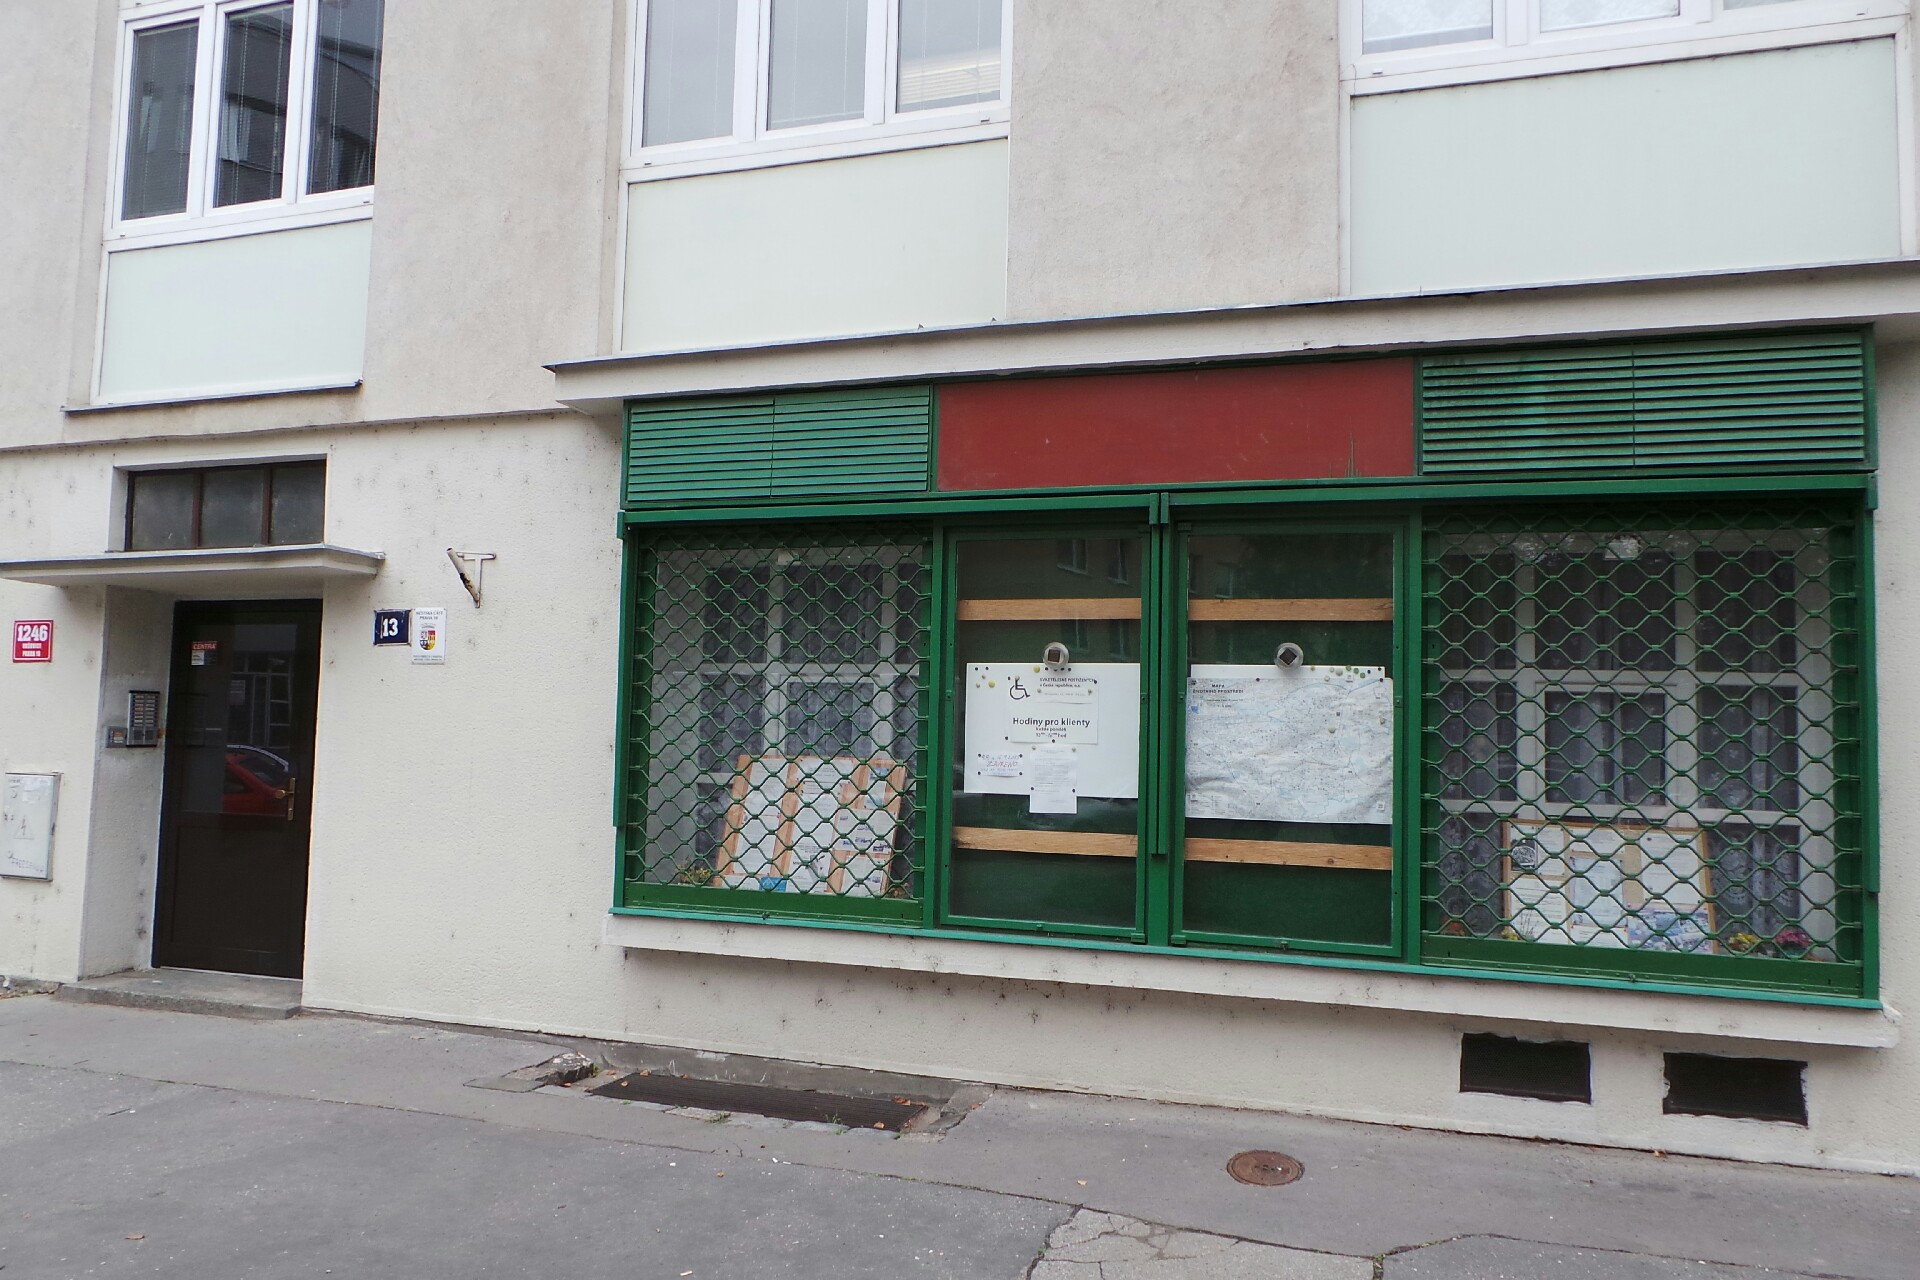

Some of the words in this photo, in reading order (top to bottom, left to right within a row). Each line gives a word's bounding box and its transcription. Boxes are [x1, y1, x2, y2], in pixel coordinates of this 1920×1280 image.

[17, 624, 49, 642] 1246
[383, 618, 399, 637] 13
[1012, 717, 1043, 727] Hodiny
[1044, 719, 1059, 727] pro
[1061, 717, 1091, 728] klienty
